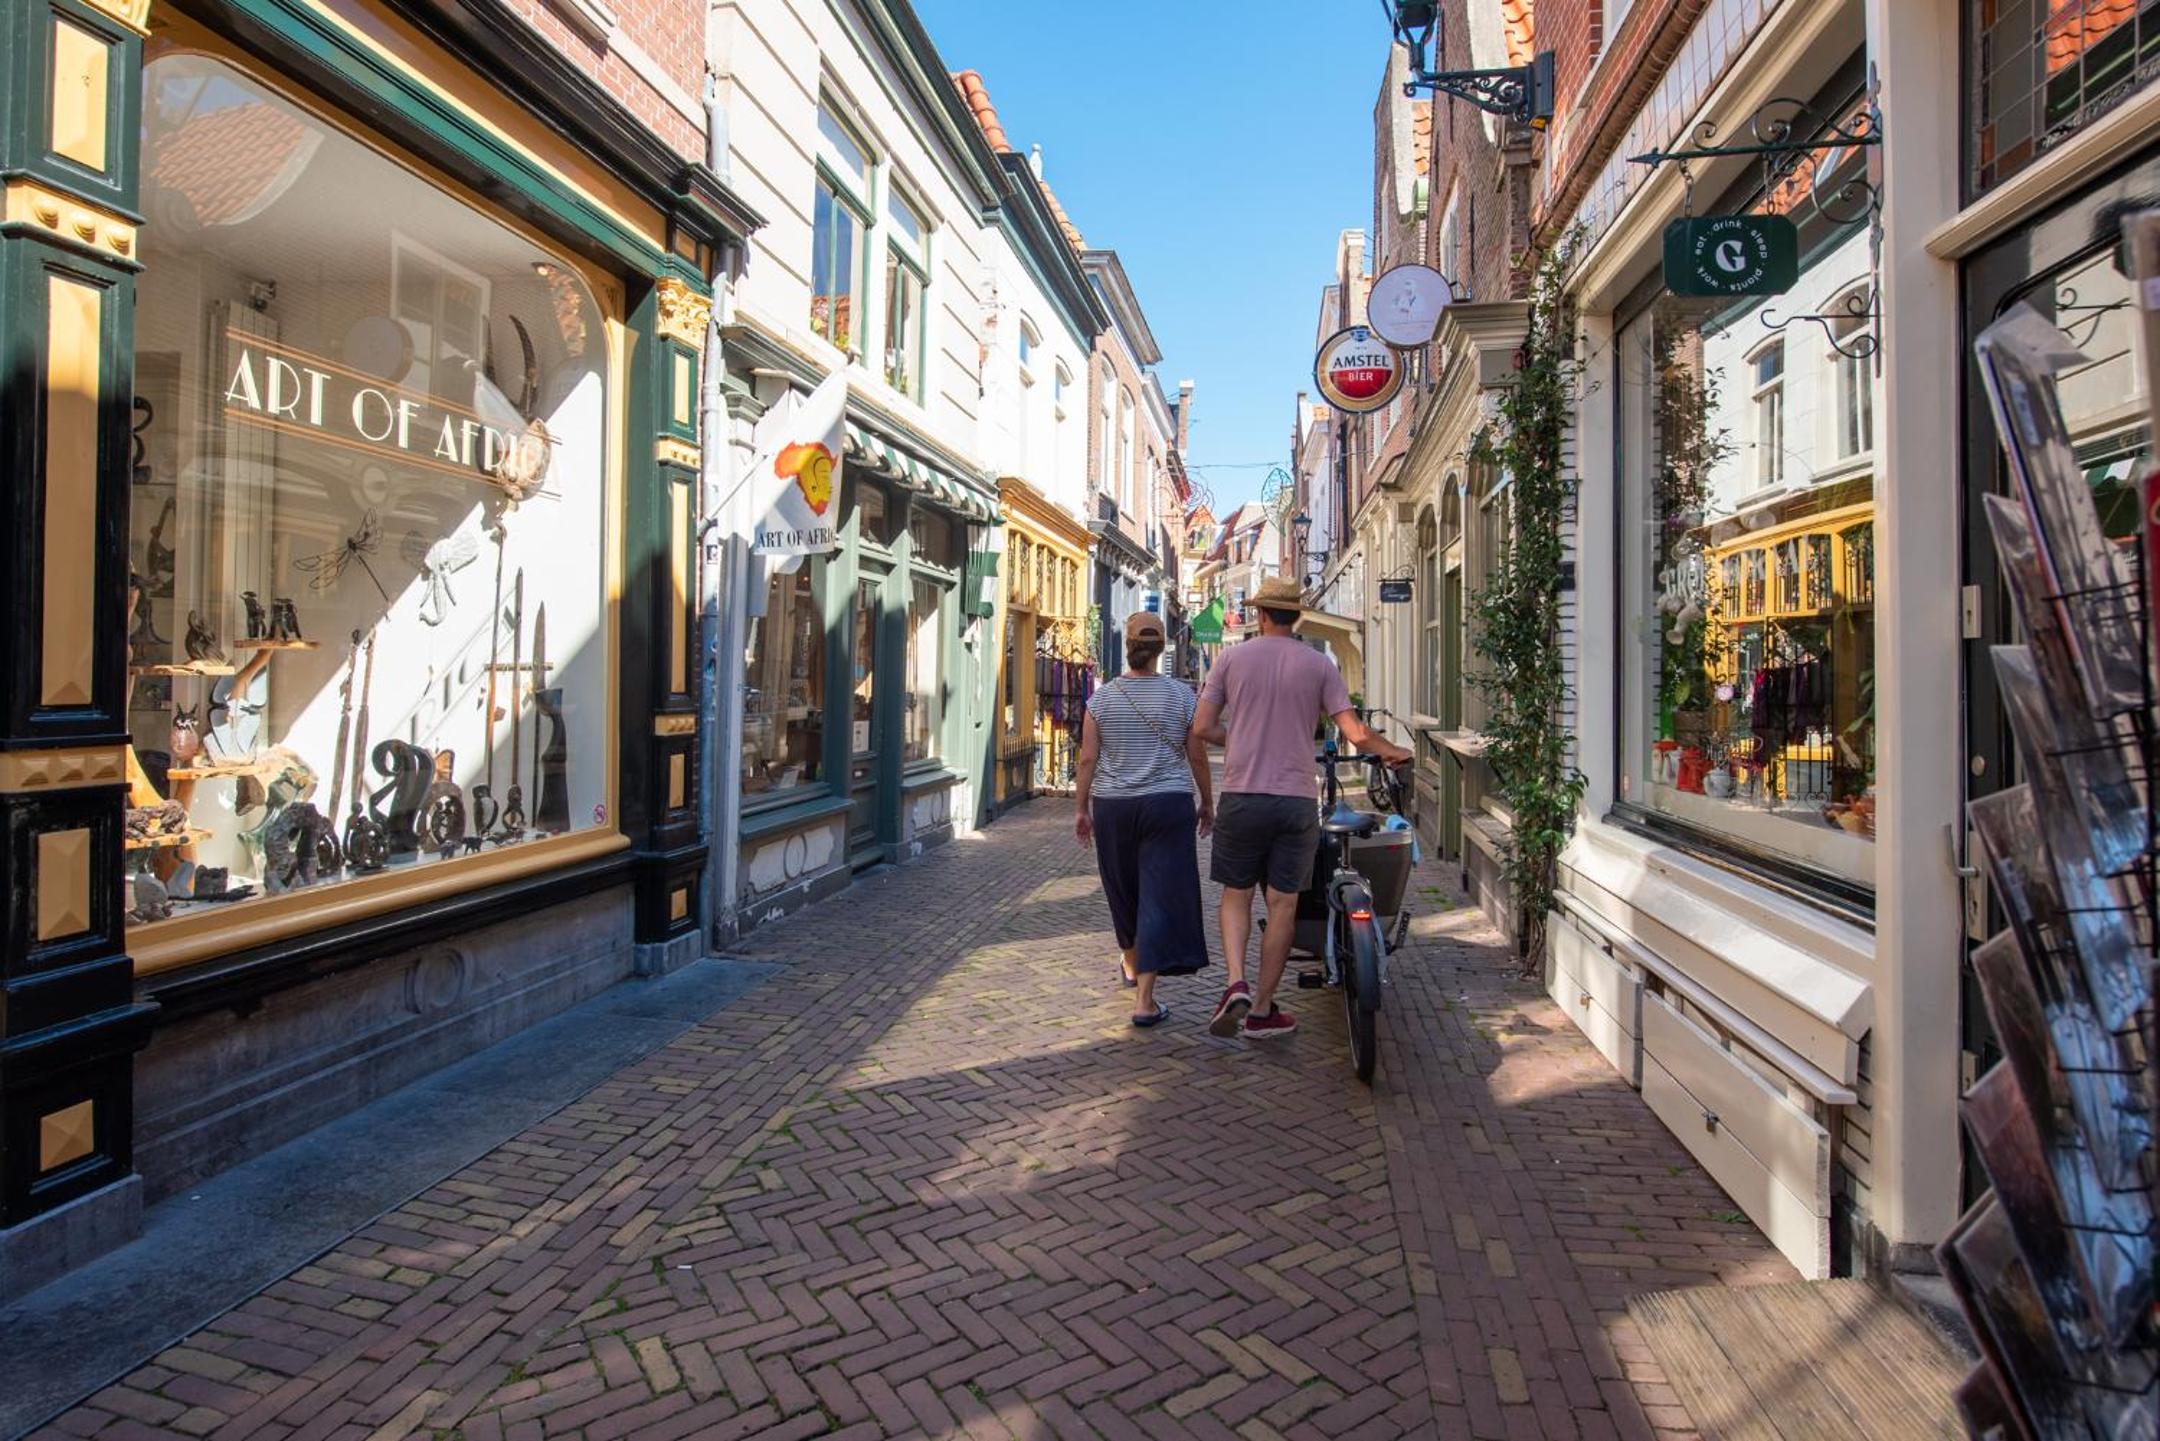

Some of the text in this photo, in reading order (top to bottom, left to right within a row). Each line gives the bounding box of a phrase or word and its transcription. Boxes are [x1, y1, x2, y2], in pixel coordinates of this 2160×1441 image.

[1712, 220, 1741, 231] drink
[1695, 236, 1707, 255] eat
[1751, 230, 1767, 258] sleep
[1716, 240, 1745, 272] G
[1697, 266, 1718, 287] work
[1730, 268, 1762, 291] plants
[1333, 355, 1388, 368] AMSTEL
[1348, 371, 1374, 382] BIER
[224, 348, 332, 427] ART
[352, 388, 421, 449] OF
[759, 531, 783, 548] ART
[787, 530, 803, 546] OF
